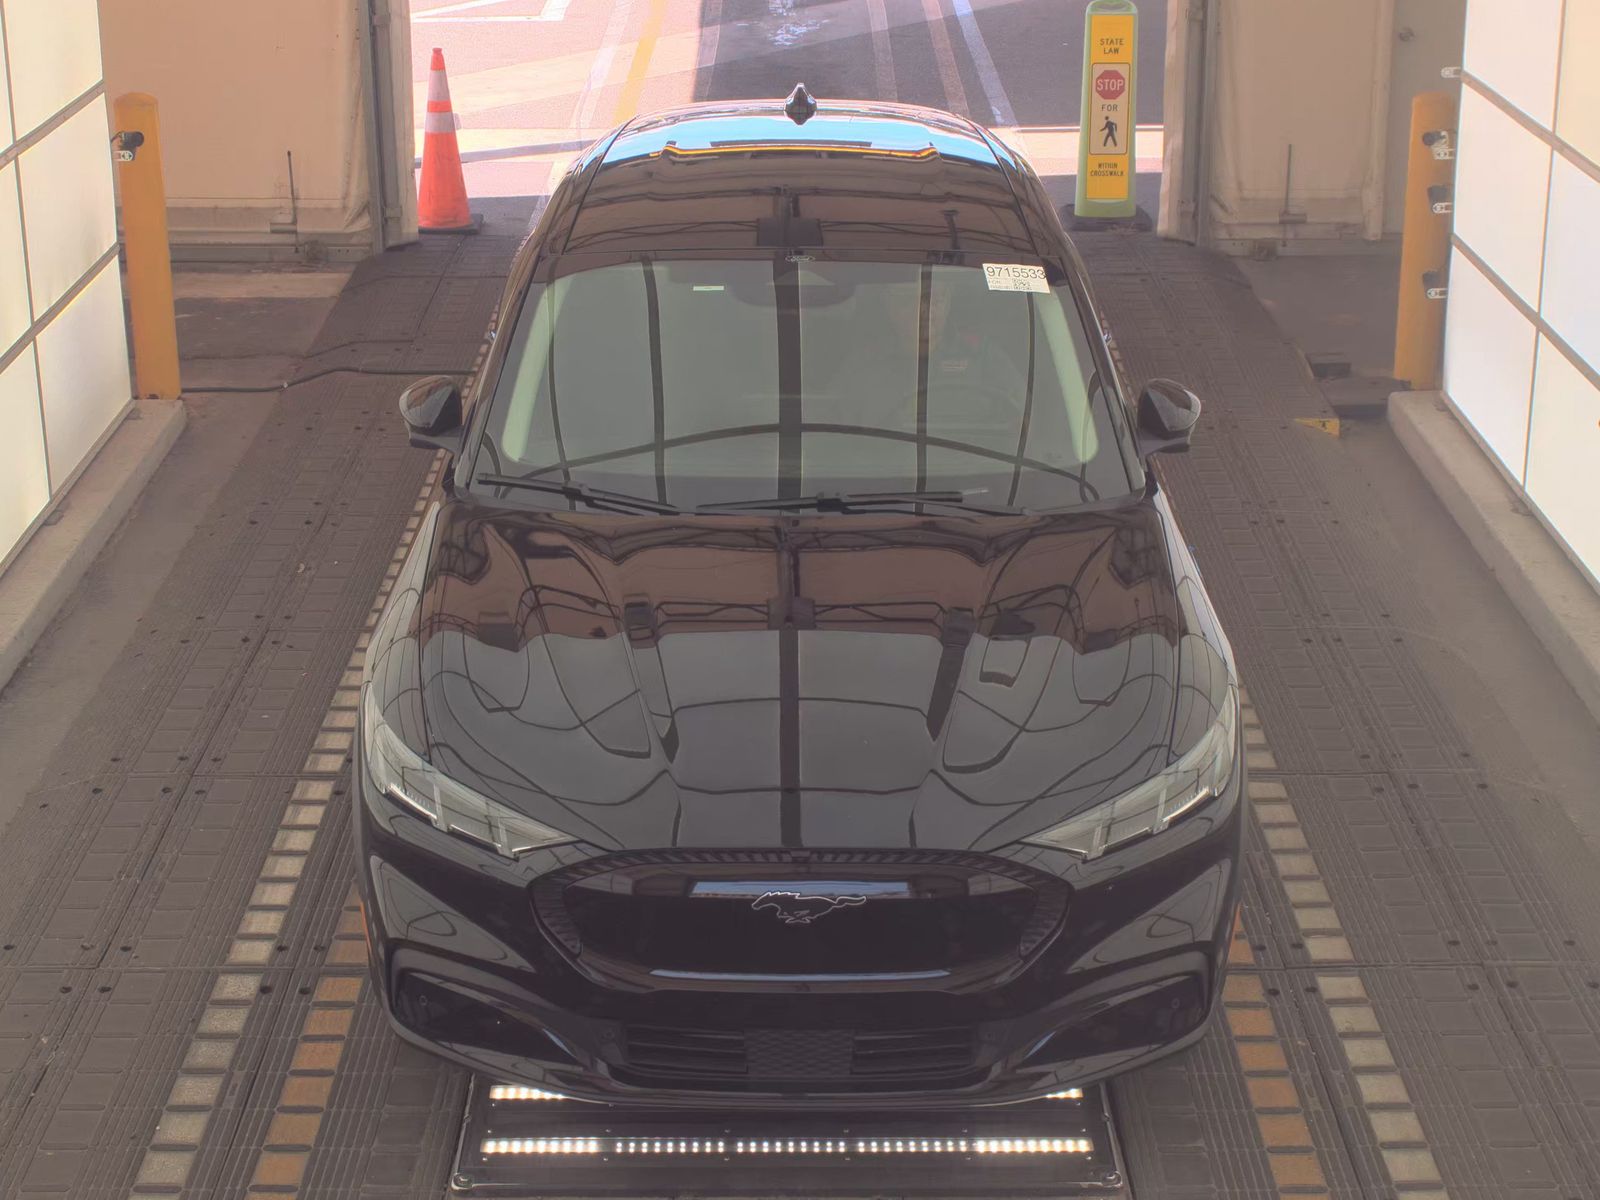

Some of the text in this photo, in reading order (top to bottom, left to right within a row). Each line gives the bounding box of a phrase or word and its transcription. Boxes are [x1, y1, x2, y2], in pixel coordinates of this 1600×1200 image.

[1100, 38, 1124, 46] STATE
[1103, 47, 1120, 55] LAW
[1097, 79, 1124, 91] STOP
[1101, 104, 1118, 112] FOR
[1090, 169, 1124, 177] CROSSWALK
[986, 266, 1046, 279] 9715533
